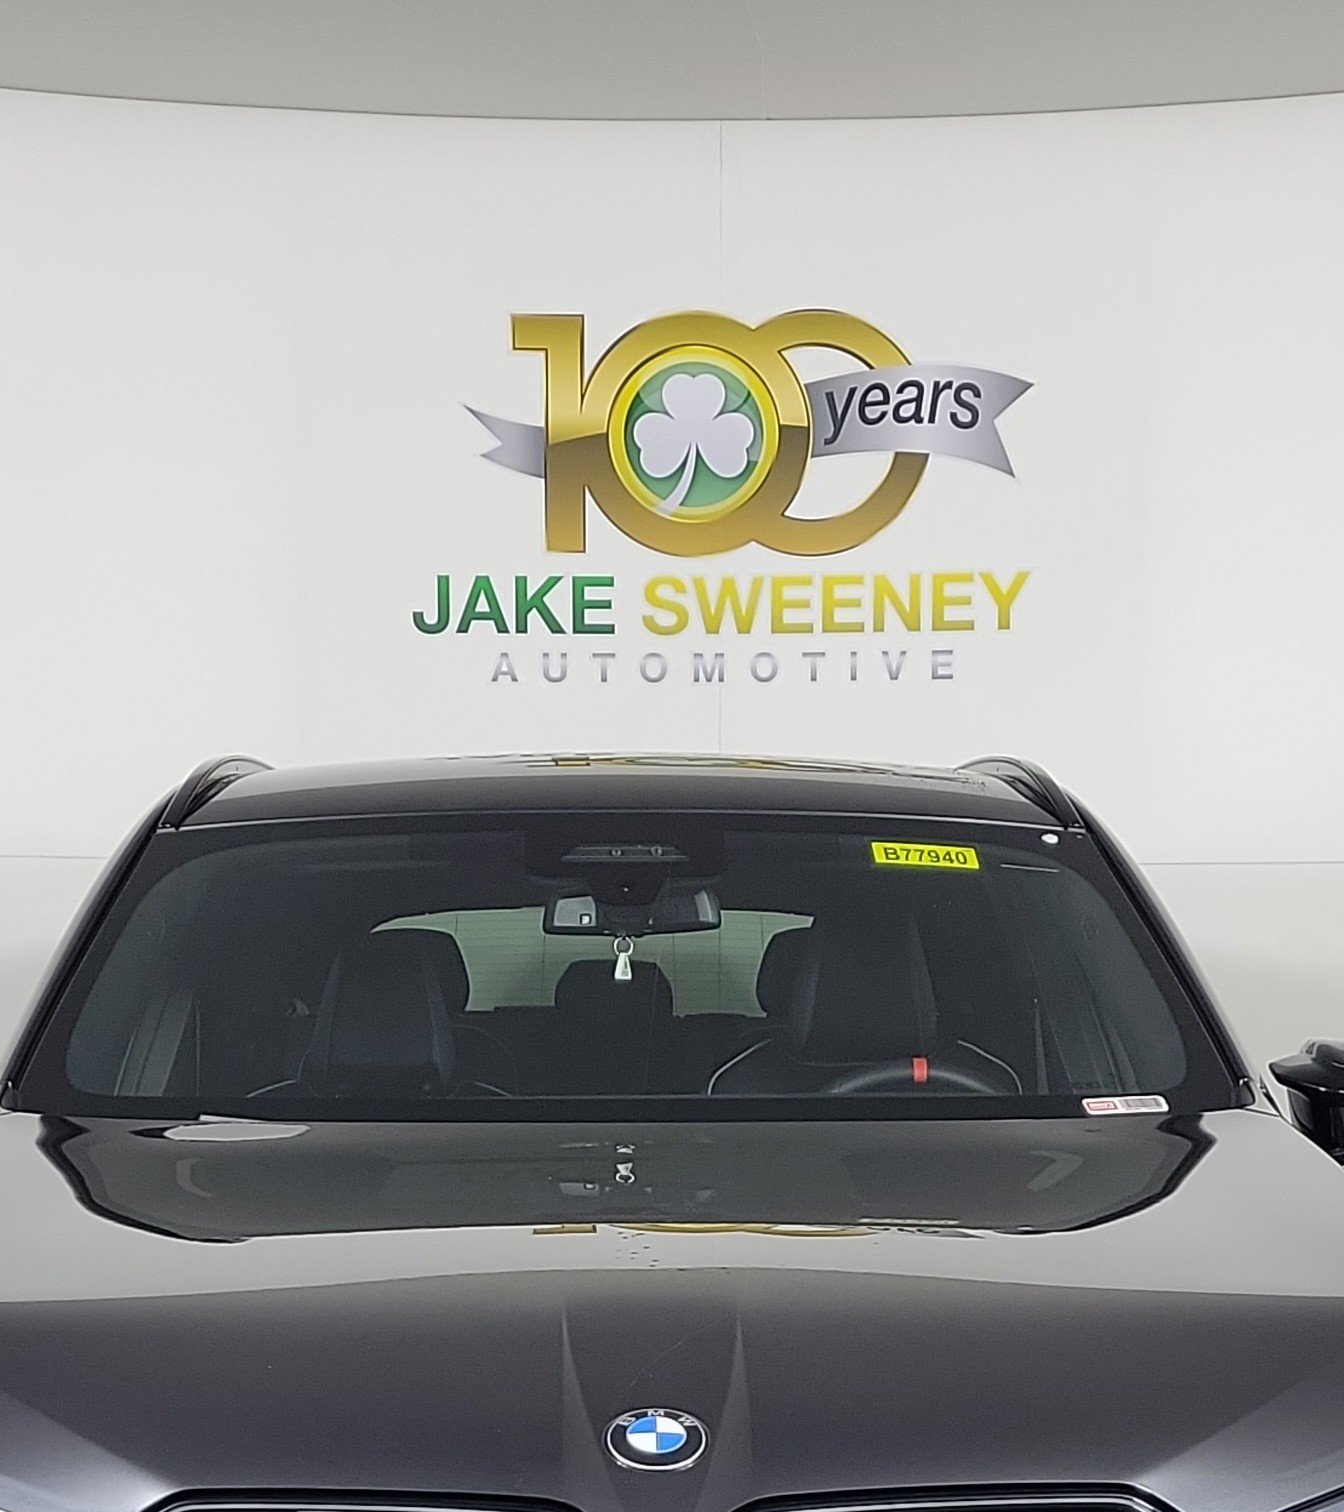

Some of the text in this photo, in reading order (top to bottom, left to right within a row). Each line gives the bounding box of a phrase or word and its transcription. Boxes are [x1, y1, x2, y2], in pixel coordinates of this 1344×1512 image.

[511, 309, 982, 557] 100 years
[412, 570, 1029, 635] JAKE SWEENEY
[491, 650, 955, 683] AUTOMOTIVE
[883, 847, 968, 865] B77940
[617, 1409, 698, 1426] BMW
